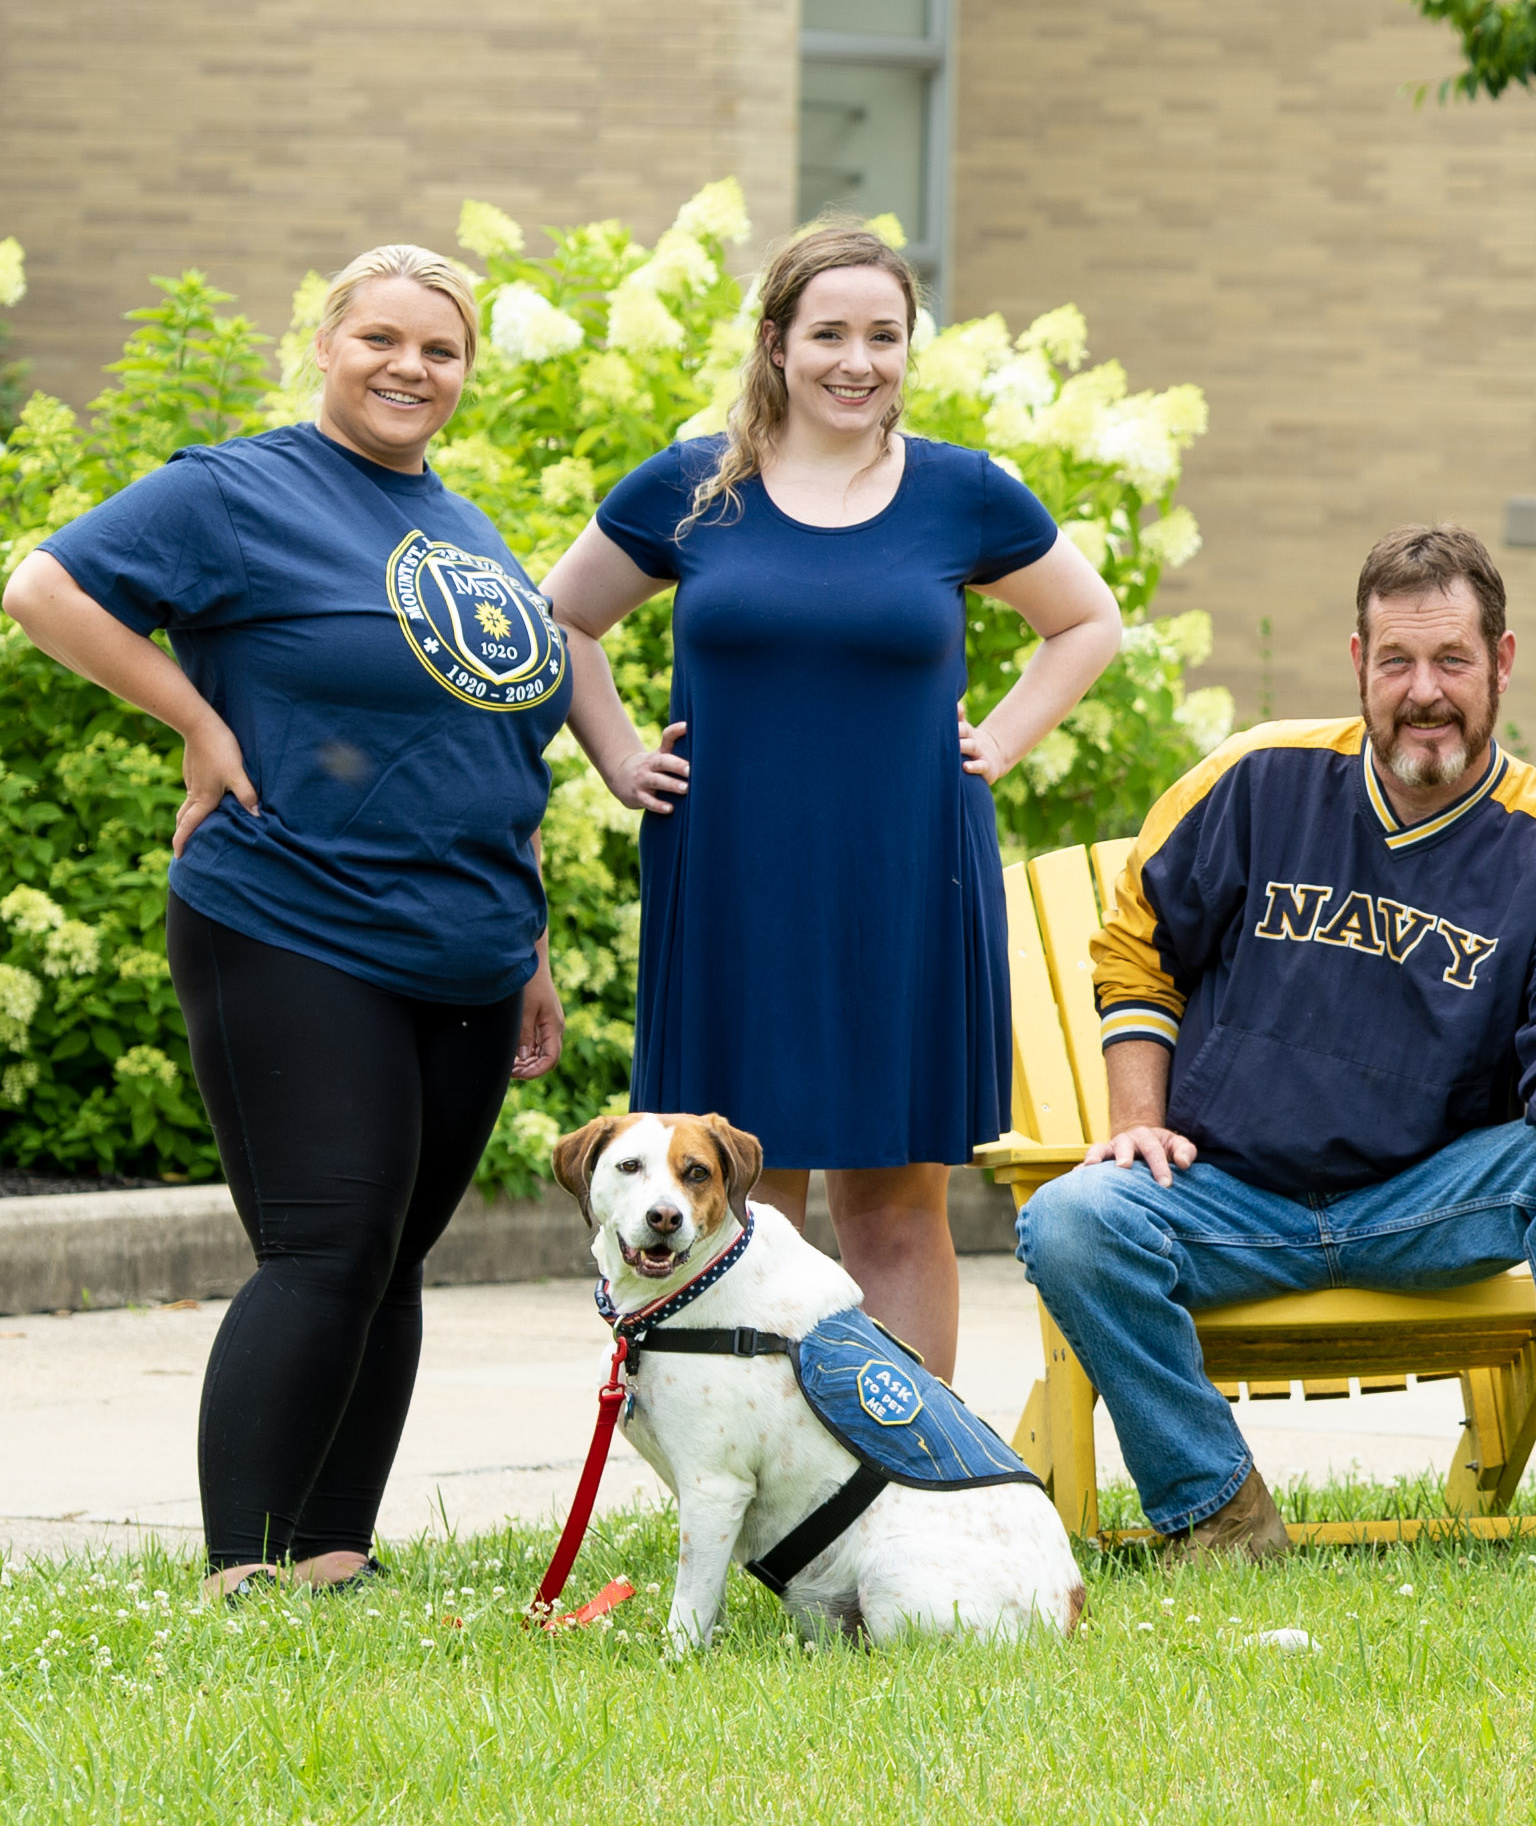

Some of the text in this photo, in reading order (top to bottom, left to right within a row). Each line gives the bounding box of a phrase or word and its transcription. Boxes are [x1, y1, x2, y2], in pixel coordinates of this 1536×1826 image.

[403, 545, 427, 568] ST.
[398, 563, 425, 620] MOUNT
[446, 570, 508, 607] MSJ
[480, 642, 518, 660] 1920
[445, 664, 487, 698] 1920
[505, 679, 545, 702] 2020
[1254, 881, 1499, 990] NAVY
[864, 1376, 906, 1415] TO PET
[876, 1371, 913, 1403] ASK
[866, 1397, 887, 1417] ME
